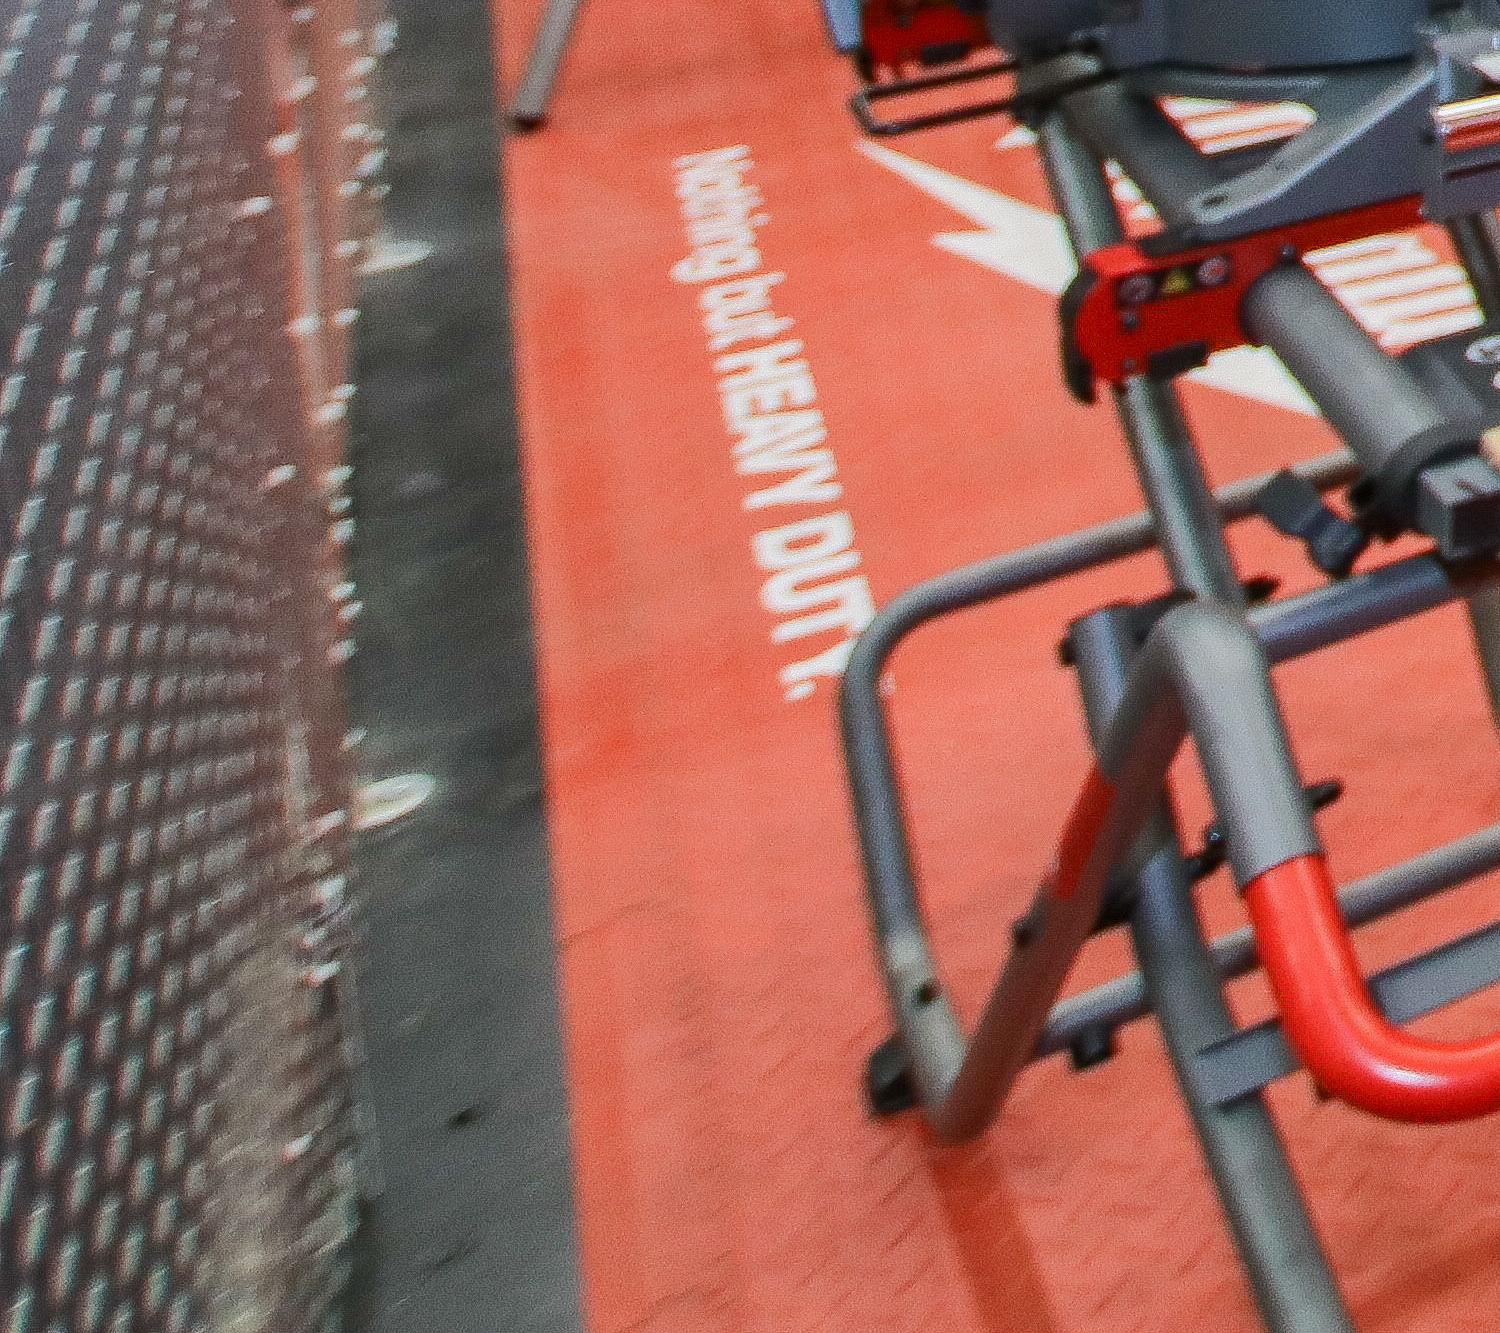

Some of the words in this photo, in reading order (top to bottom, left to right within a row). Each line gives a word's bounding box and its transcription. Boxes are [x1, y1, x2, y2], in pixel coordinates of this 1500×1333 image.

[671, 142, 769, 285] Nothing
[698, 271, 793, 351] but
[713, 338, 844, 512] HEAVY
